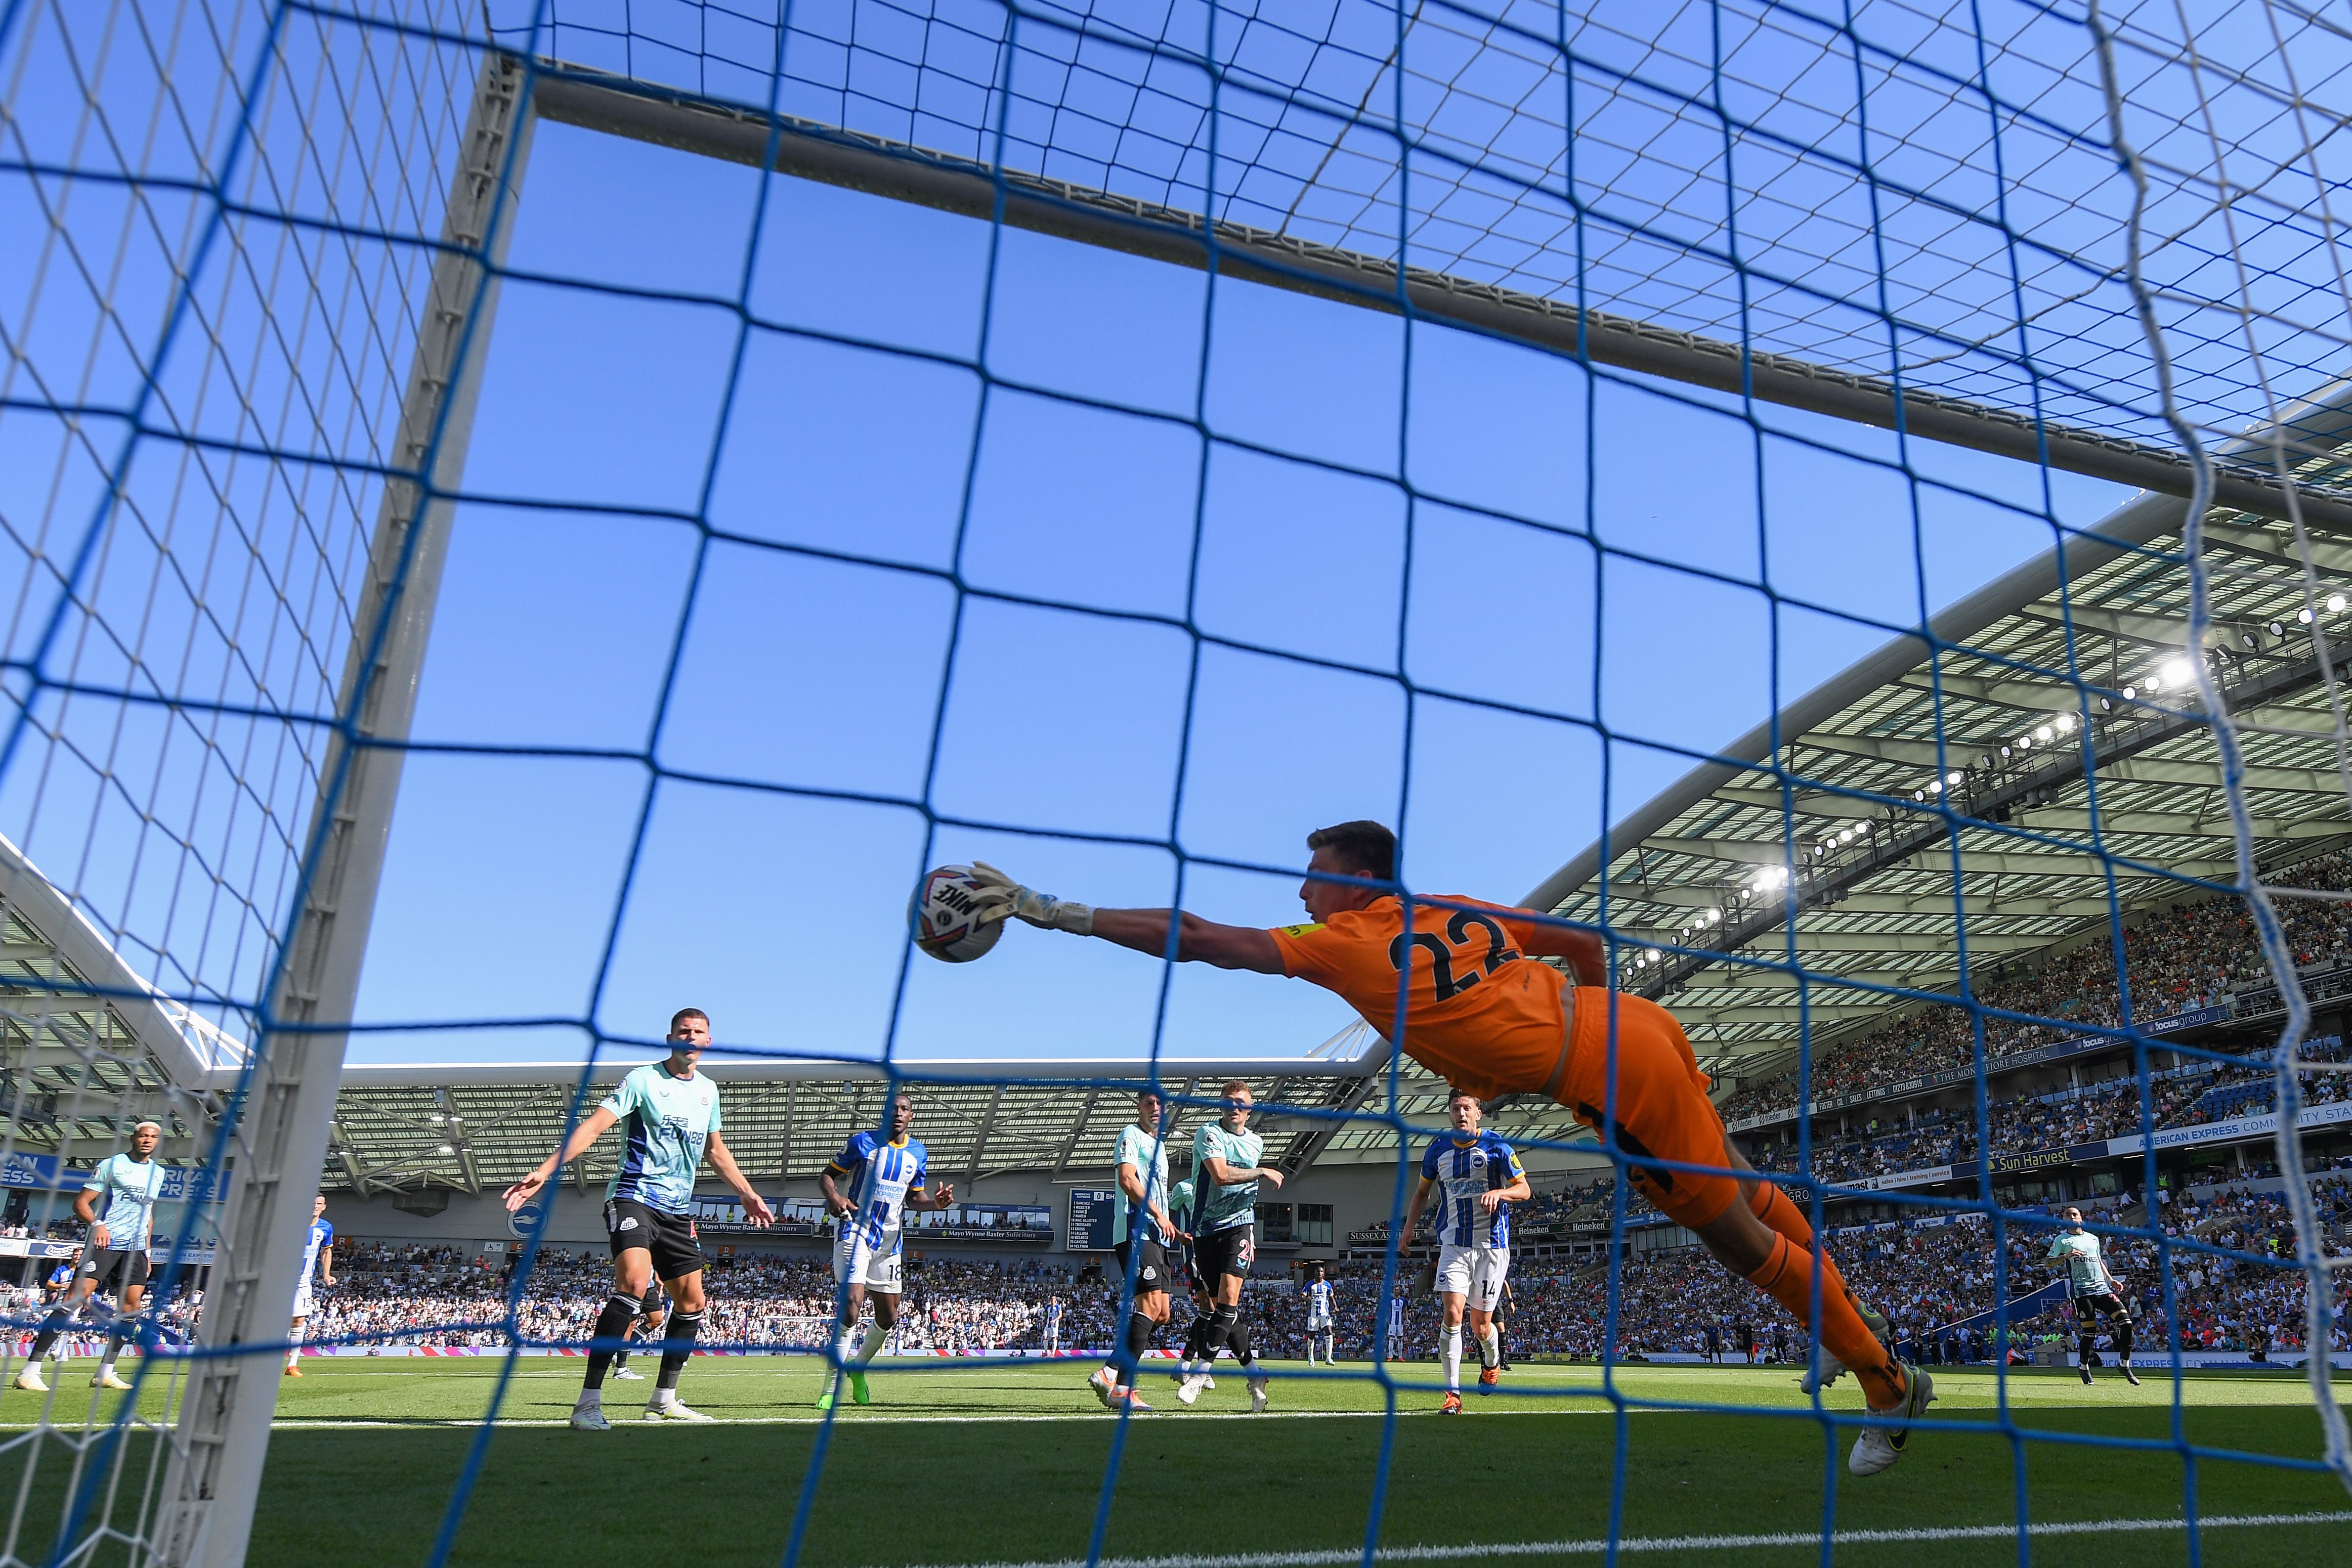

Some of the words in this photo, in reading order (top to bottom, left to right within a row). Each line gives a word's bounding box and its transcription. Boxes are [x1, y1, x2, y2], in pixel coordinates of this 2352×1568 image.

[933, 884, 980, 916] NIKE
[1388, 910, 1521, 1003] 22
[1940, 1072, 1955, 1082] THE
[1957, 1059, 2009, 1077] MONFIORE
[2012, 1050, 2049, 1065] HOSPITAL
[1819, 1101, 1833, 1110] FOSTER
[1849, 1094, 1862, 1103] SALES
[1866, 1087, 1886, 1099] LETTINGS
[1737, 1118, 1753, 1128] fileder
[1765, 1112, 1781, 1122] fileder
[2192, 1124, 2239, 1139] EXPRESS
[2243, 1111, 2319, 1131] COMMITY
[658, 1127, 704, 1146] FUN88
[1999, 1157, 2021, 1170] Sun
[2023, 1148, 2070, 1167] Harvest
[1446, 1181, 1484, 1189] AMERICAN
[1909, 1173, 1928, 1182] training
[873, 1183, 904, 1193] MERICAN
[1518, 1226, 1549, 1235] Heineken
[1572, 1222, 1605, 1231] Heineken
[888, 1265, 901, 1282] 18
[1482, 1279, 1495, 1299] 14
[2131, 1360, 2176, 1368] EXPRES
